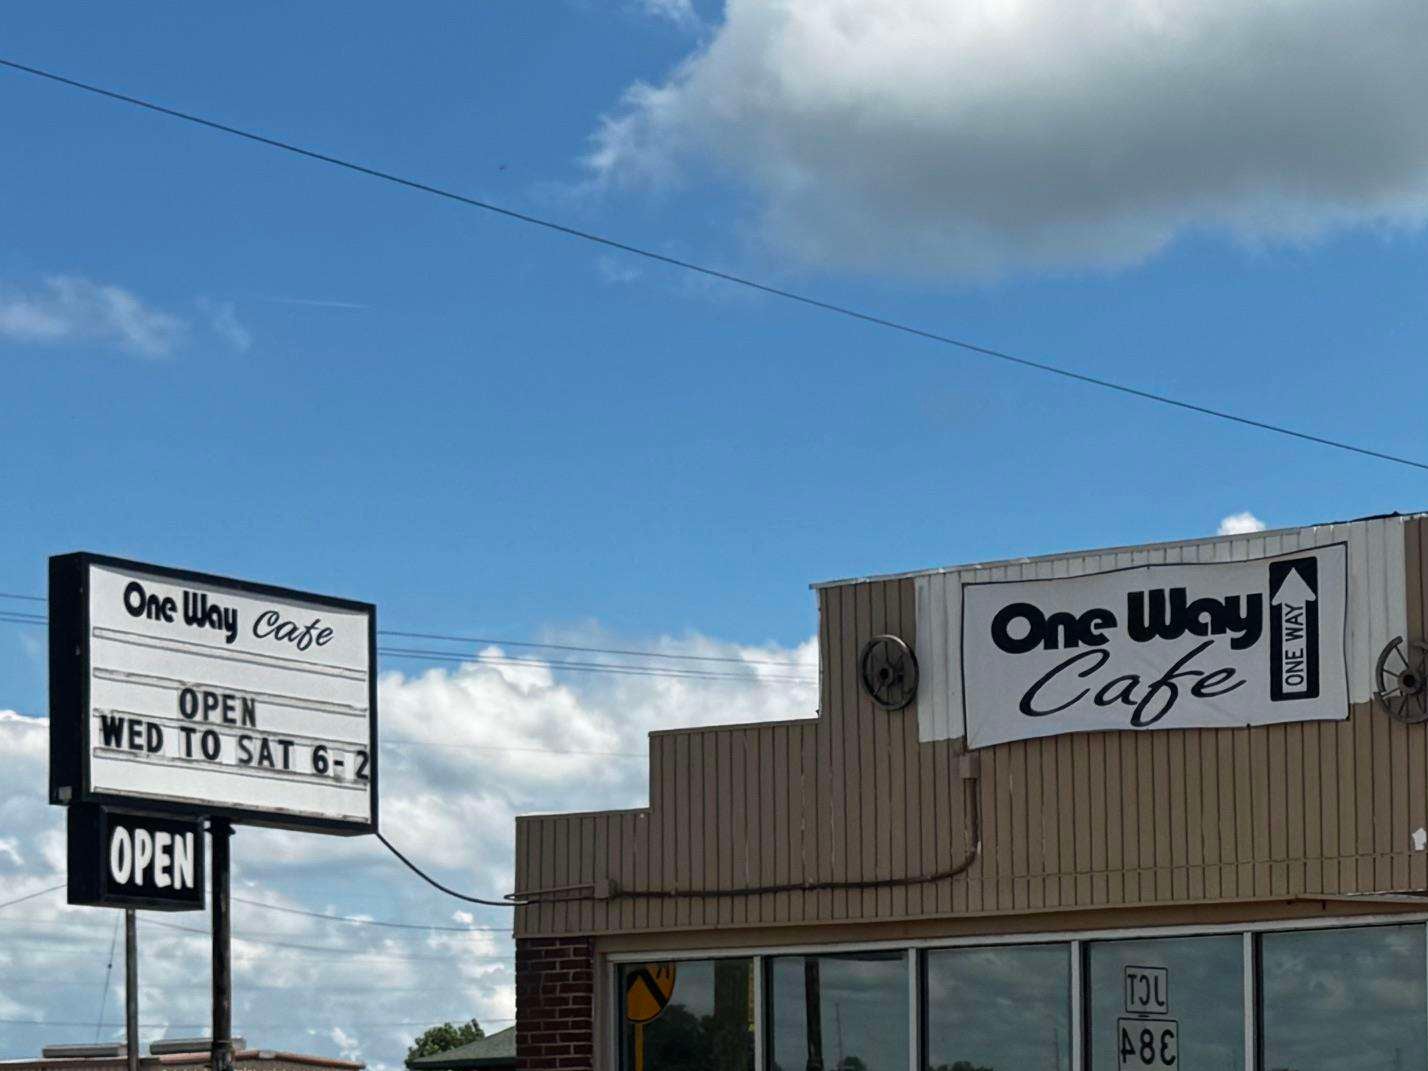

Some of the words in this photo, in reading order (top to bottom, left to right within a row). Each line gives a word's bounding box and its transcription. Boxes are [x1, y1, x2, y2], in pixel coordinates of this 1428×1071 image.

[124, 582, 177, 620] One
[183, 590, 238, 644] Way
[252, 610, 334, 651] Cafe
[990, 602, 1117, 655] One
[1127, 587, 1263, 650] Way
[1284, 602, 1304, 645] WAY
[1018, 640, 1247, 727] Cafe
[1284, 648, 1304, 687] ONE
[178, 687, 257, 728] OPEN
[100, 714, 164, 754] WED
[180, 727, 221, 762] TO
[237, 734, 295, 773] SAT
[109, 826, 195, 890] OPEN
